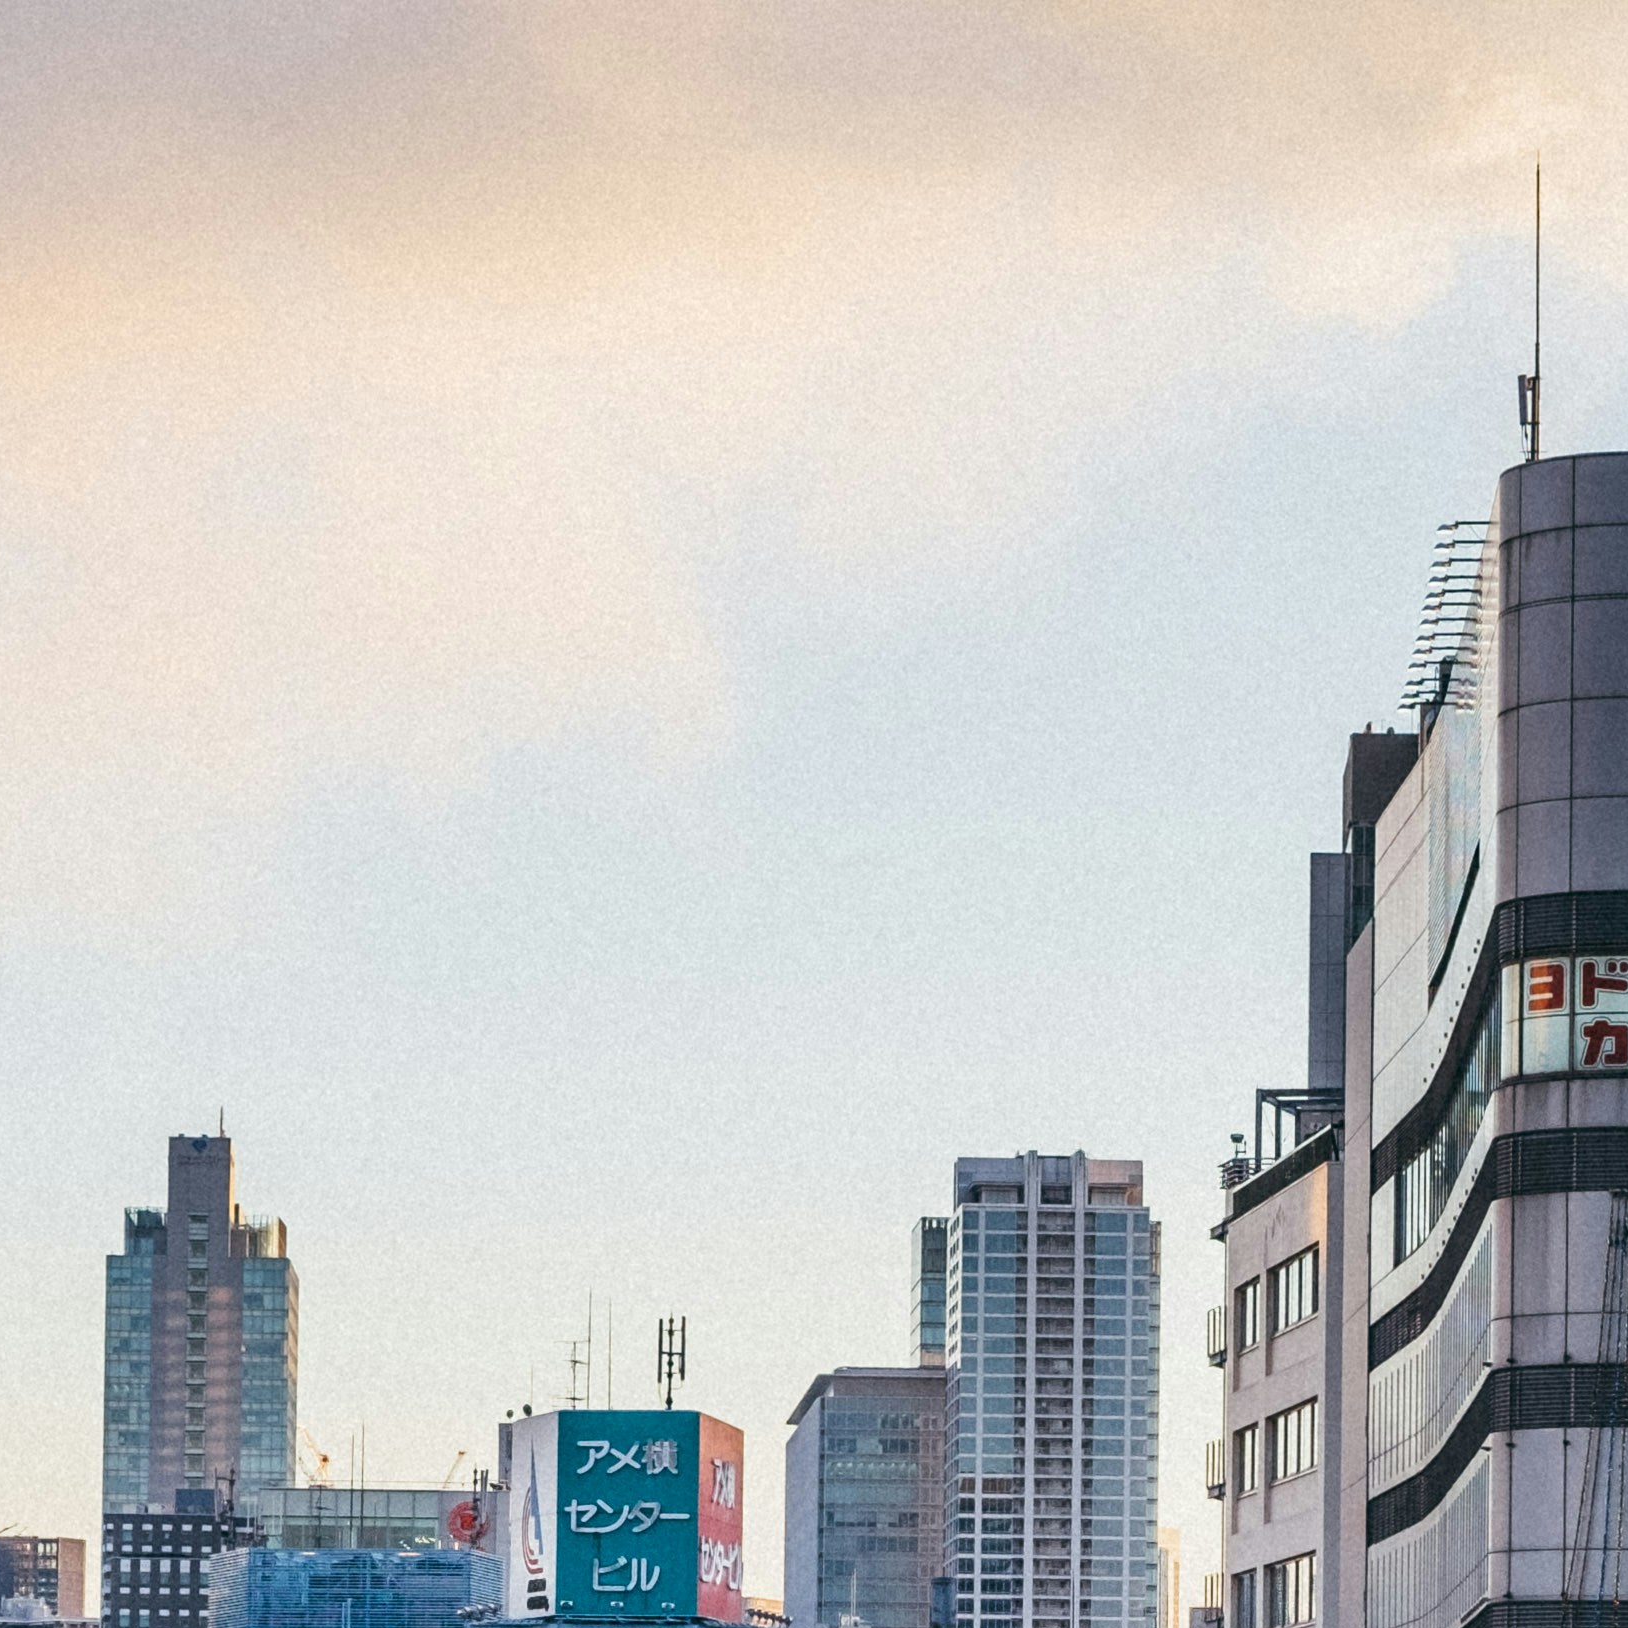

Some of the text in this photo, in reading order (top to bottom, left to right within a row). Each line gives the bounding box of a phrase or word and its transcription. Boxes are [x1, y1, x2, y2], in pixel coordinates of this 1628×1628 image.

[576, 1437, 678, 1476] アメ横
[563, 1498, 690, 1534] センター
[592, 1555, 661, 1592] ビル
